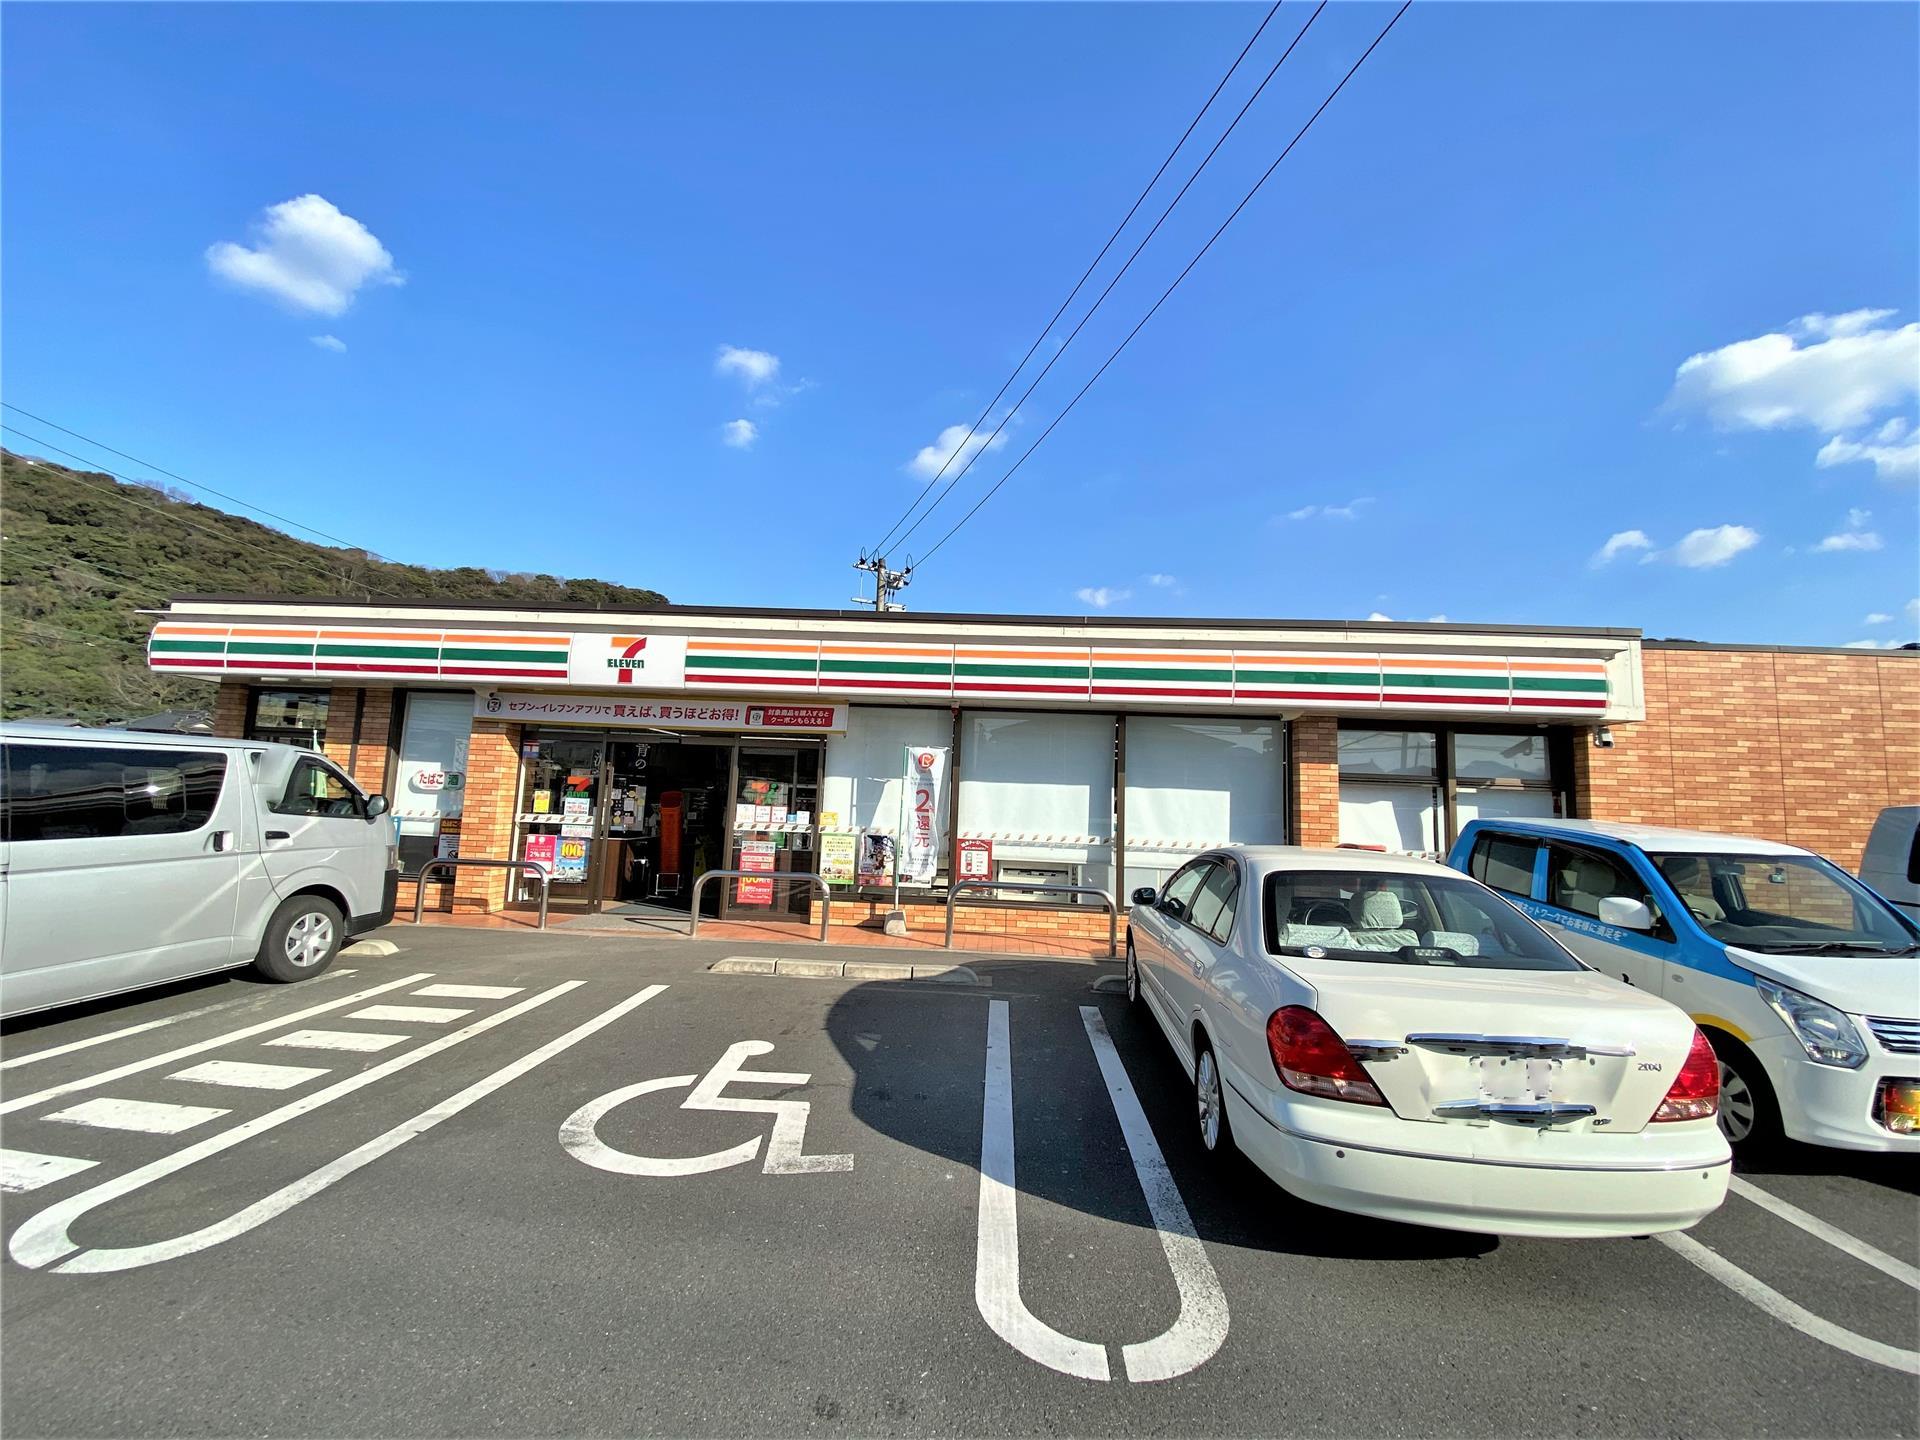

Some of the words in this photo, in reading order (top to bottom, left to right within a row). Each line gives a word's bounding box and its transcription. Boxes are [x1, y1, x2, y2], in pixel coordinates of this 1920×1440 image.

[611, 637, 647, 683] 7
[419, 773, 444, 785] たばこ
[447, 774, 459, 786] 酒
